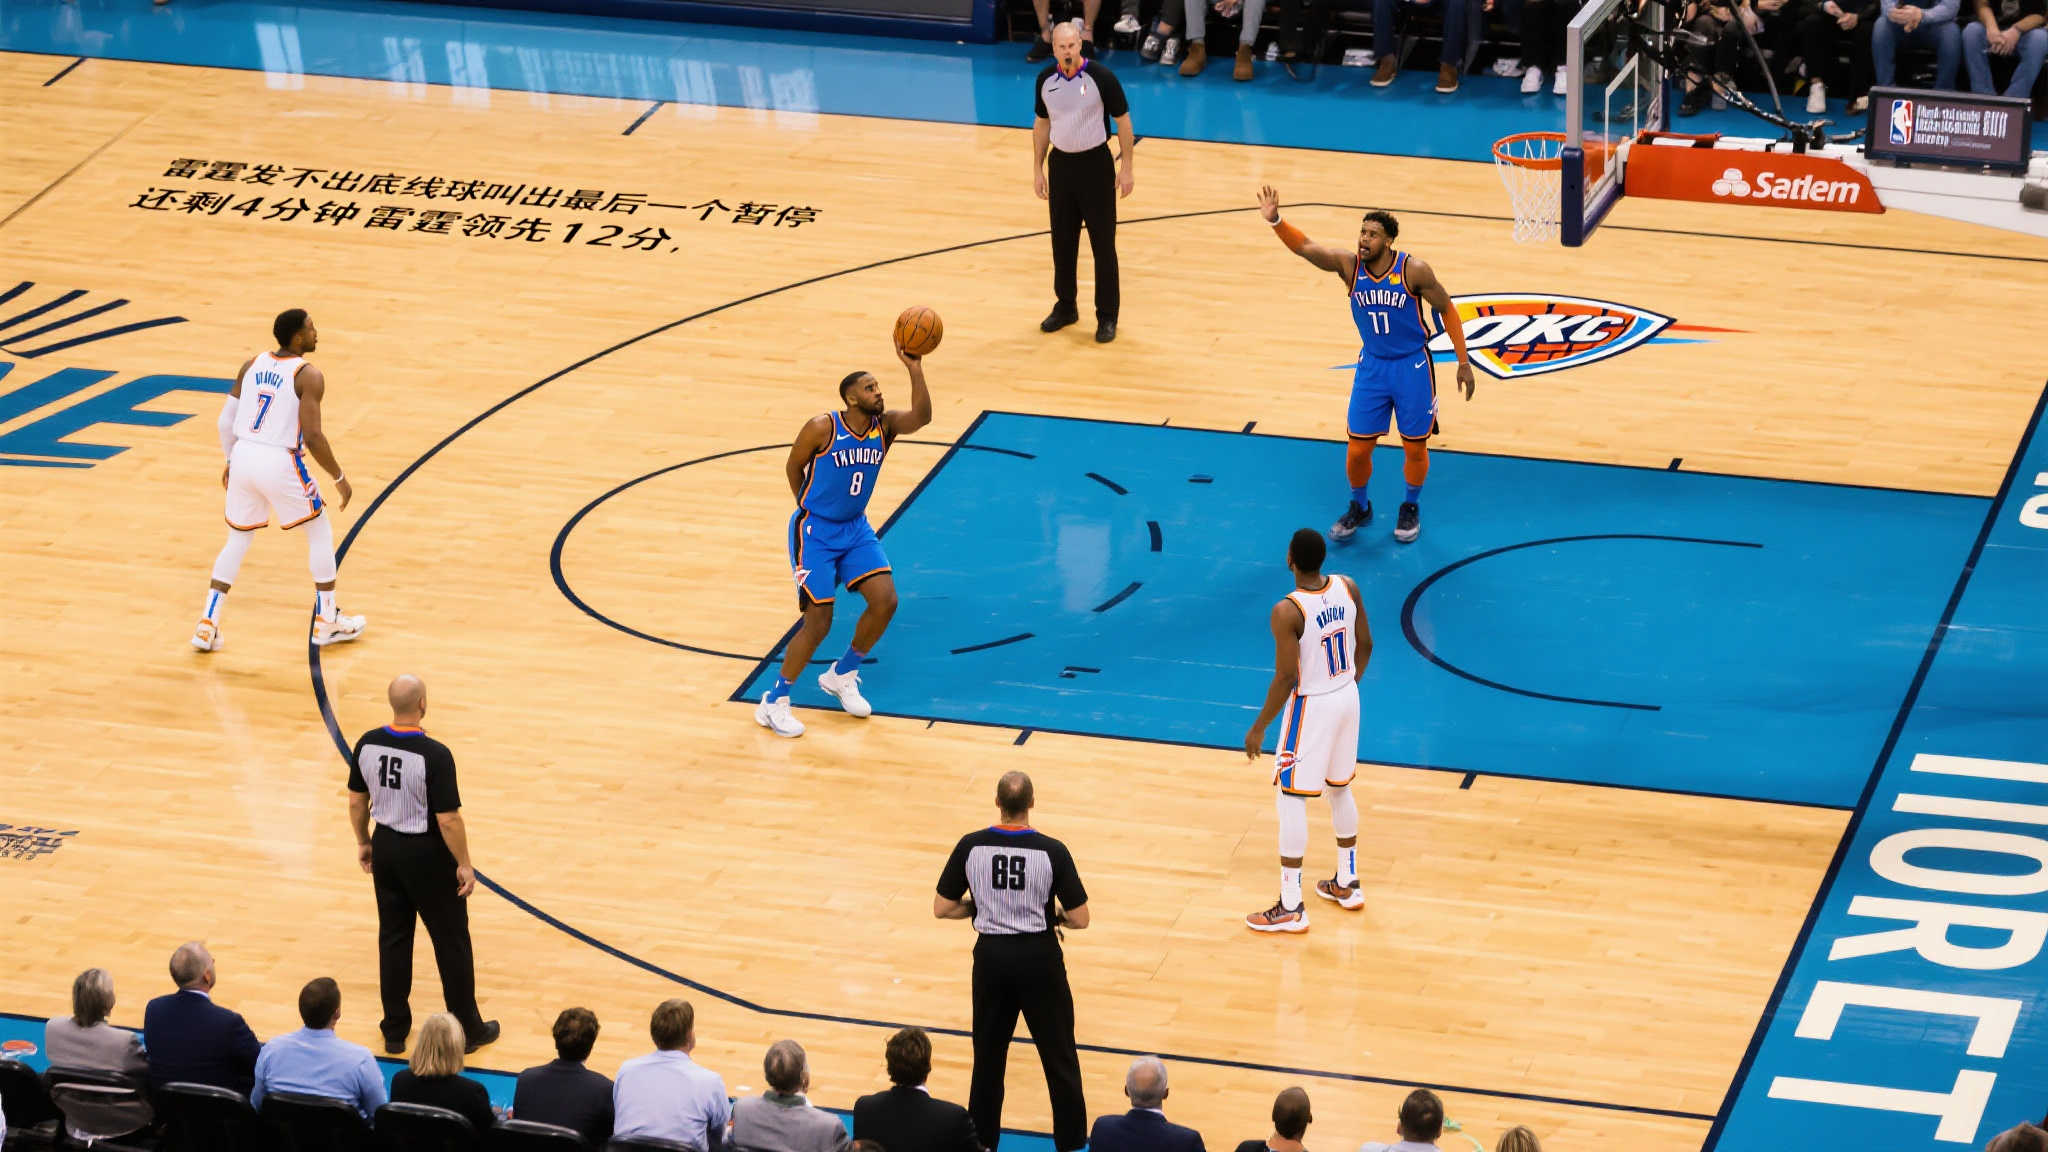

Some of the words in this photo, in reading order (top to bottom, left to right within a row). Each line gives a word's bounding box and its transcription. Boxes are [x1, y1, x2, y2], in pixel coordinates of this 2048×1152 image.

[1436, 314, 1626, 350] OKC
[250, 391, 275, 433] 7
[849, 471, 864, 497] 8
